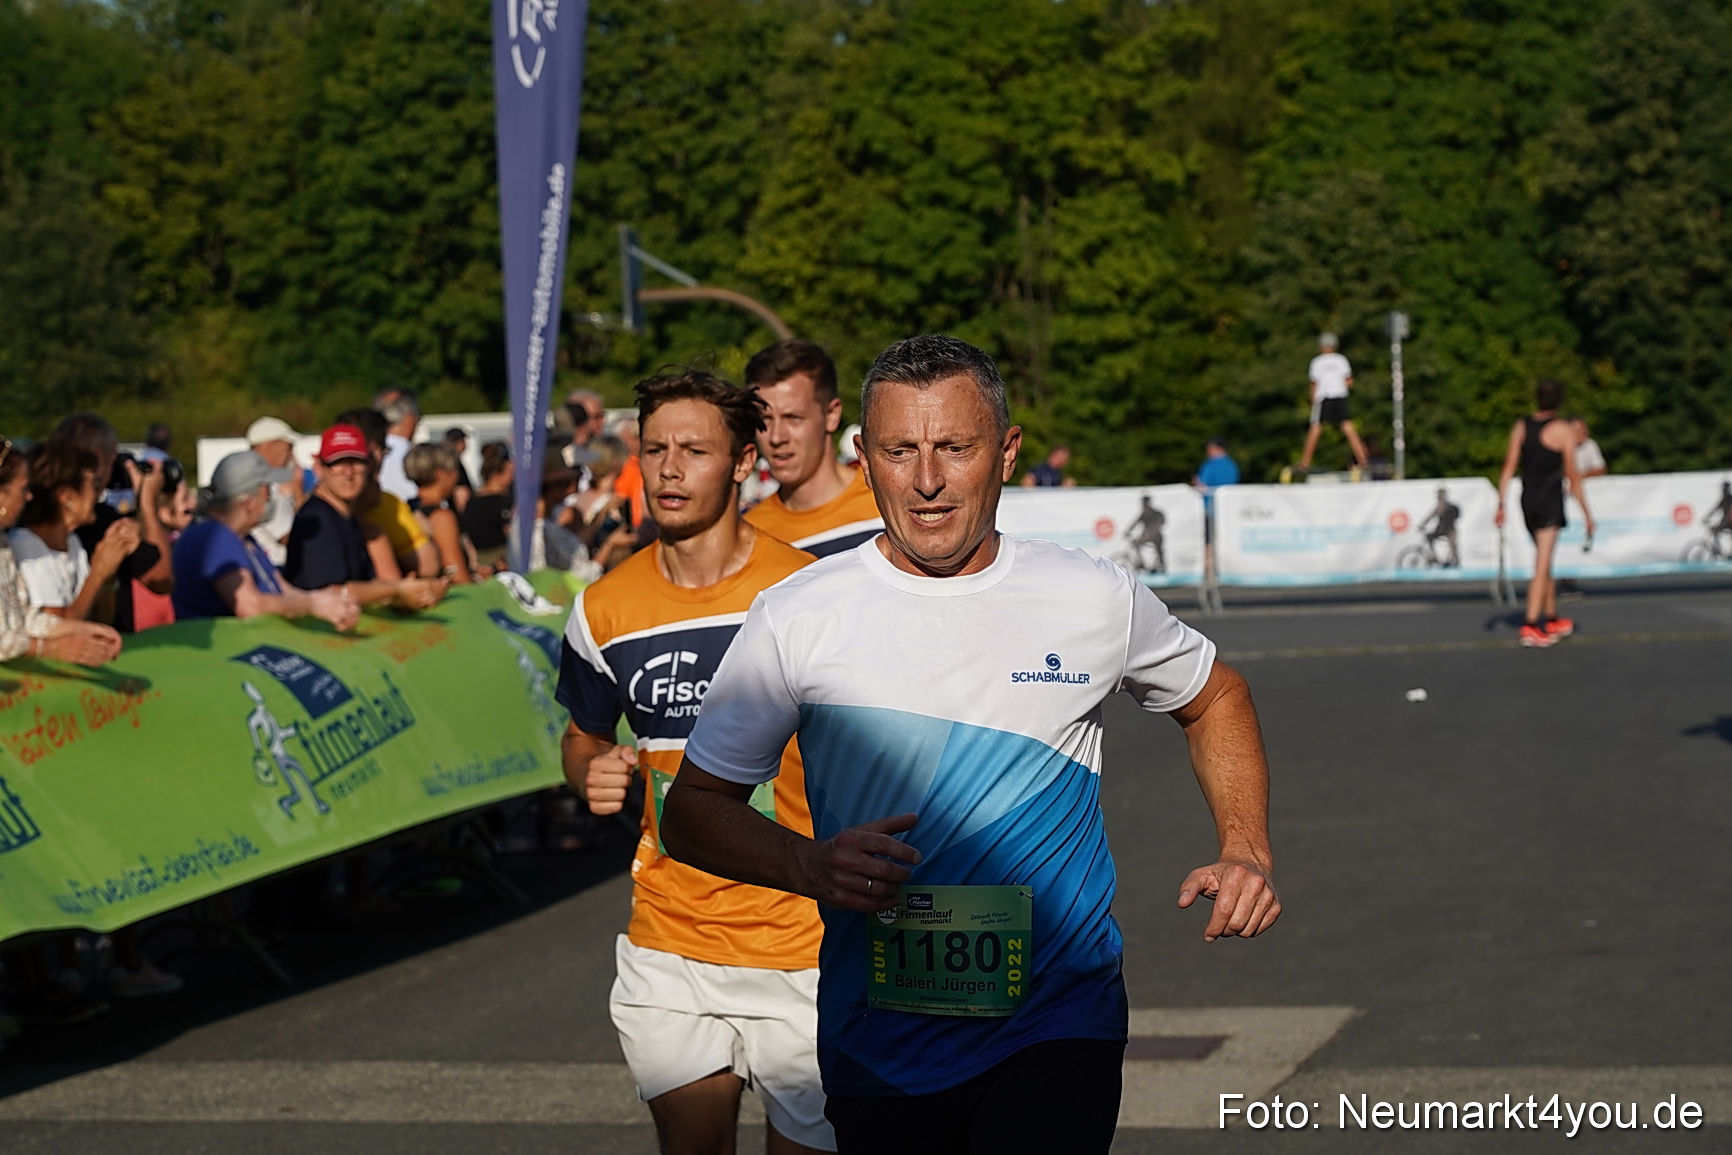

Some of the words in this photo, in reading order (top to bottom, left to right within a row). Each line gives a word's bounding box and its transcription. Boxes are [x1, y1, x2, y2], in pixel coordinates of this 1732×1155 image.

[1011, 671, 1090, 684] SCHABMÜLLER
[651, 676, 714, 706] Fisc
[664, 704, 701, 718] AUTO
[900, 909, 954, 920] Firmenlauf
[920, 917, 952, 925] neumarkt
[889, 931, 1001, 973] 1180
[874, 941, 886, 983] RUN
[1008, 938, 1022, 997] 2022
[895, 975, 935, 990] Baierl
[941, 977, 996, 994] Jürgen
